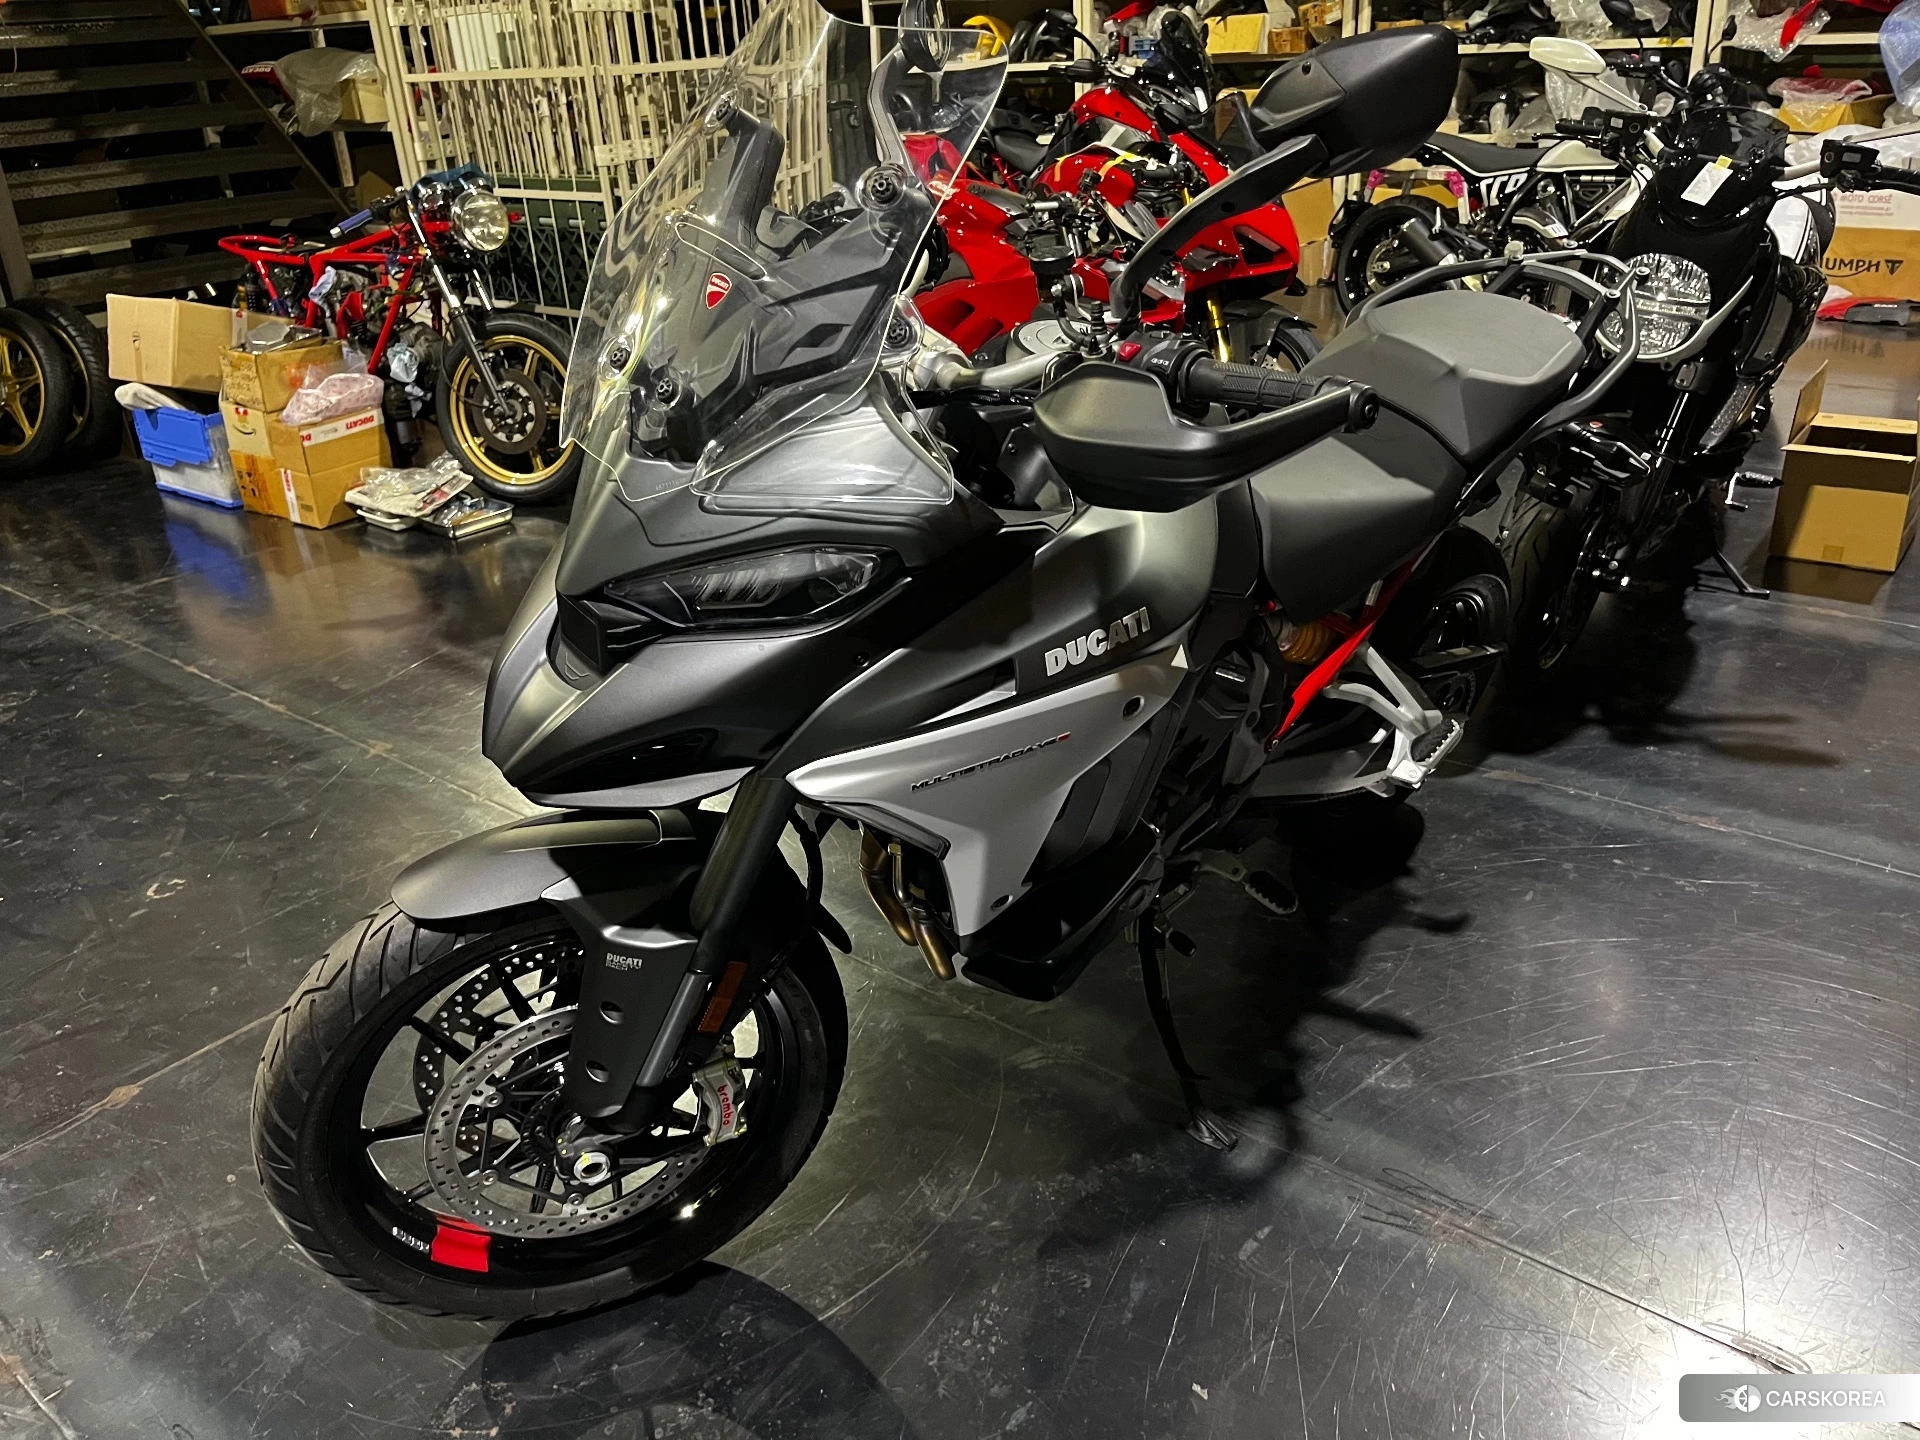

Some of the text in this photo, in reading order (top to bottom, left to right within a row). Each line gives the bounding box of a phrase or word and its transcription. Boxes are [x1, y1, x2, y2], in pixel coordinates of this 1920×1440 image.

[345, 414, 375, 430] DUCATI
[1044, 606, 1151, 677] DUCATI
[606, 952, 643, 967] DUCATI
[717, 1083, 735, 1126] brembo
